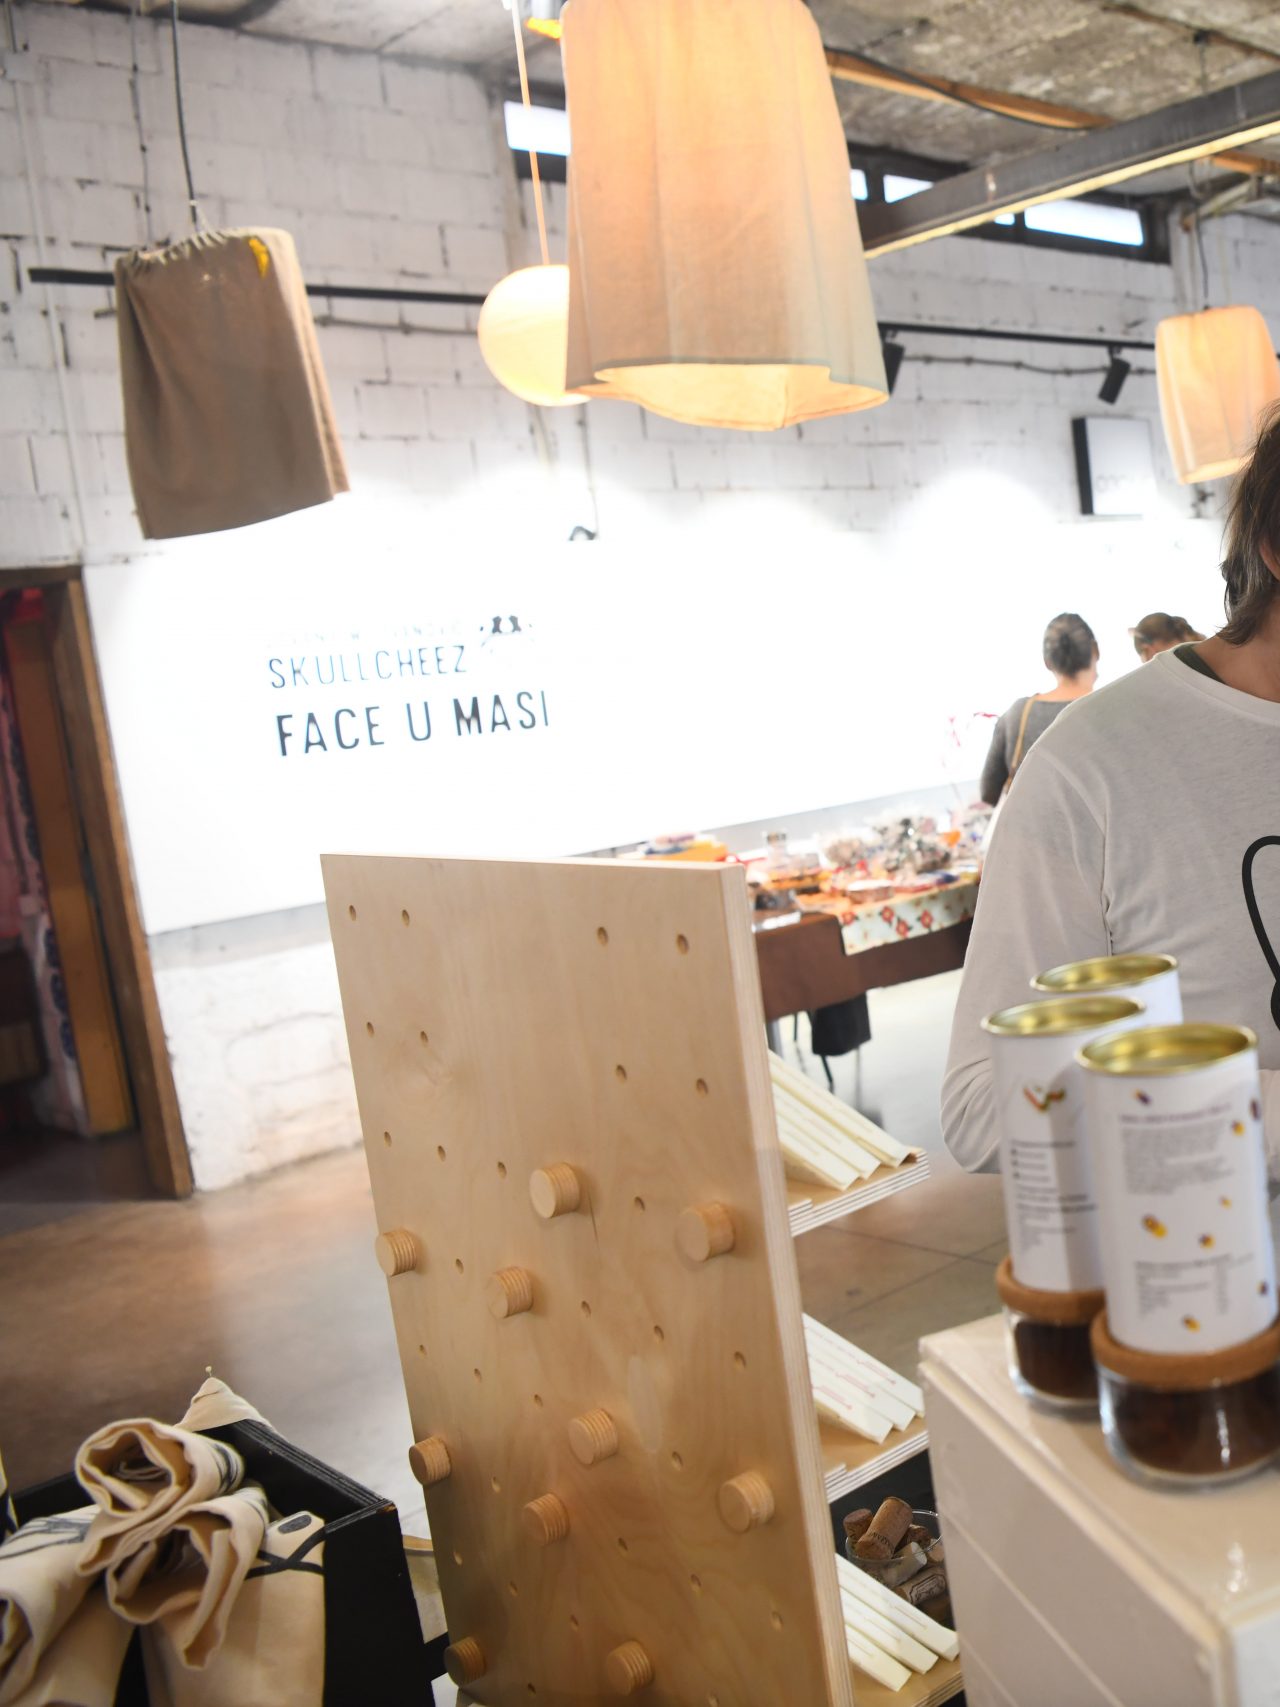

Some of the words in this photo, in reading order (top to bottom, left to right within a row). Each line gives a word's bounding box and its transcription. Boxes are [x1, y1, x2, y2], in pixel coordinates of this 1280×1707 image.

[268, 644, 467, 689] SKULLCHEEZ
[276, 705, 385, 757] FACE
[406, 701, 432, 741] U
